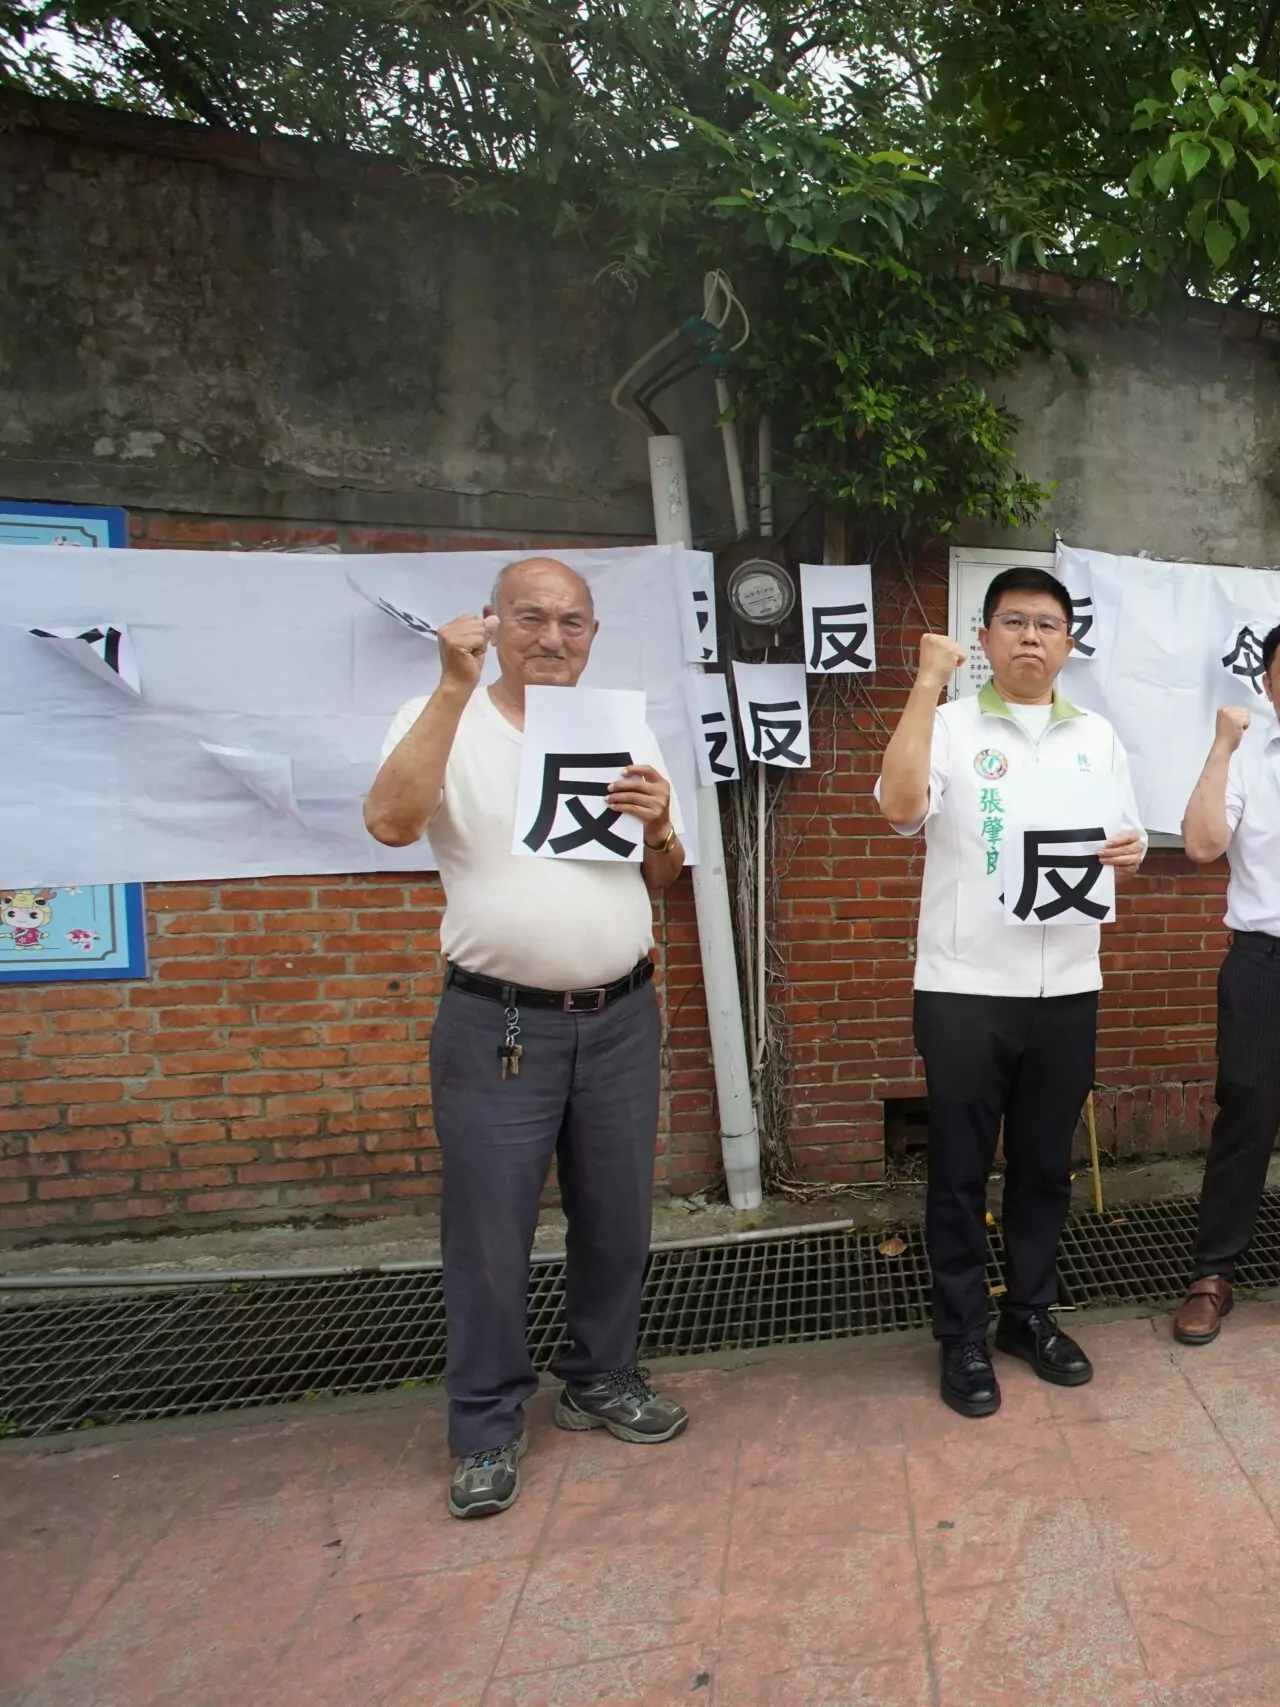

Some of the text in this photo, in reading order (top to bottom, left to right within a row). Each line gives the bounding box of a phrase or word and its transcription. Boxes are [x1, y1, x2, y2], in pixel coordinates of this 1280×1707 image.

[809, 602, 872, 671] 反
[748, 700, 807, 766] 反
[522, 752, 638, 858] 反
[1012, 827, 1111, 921] 反
